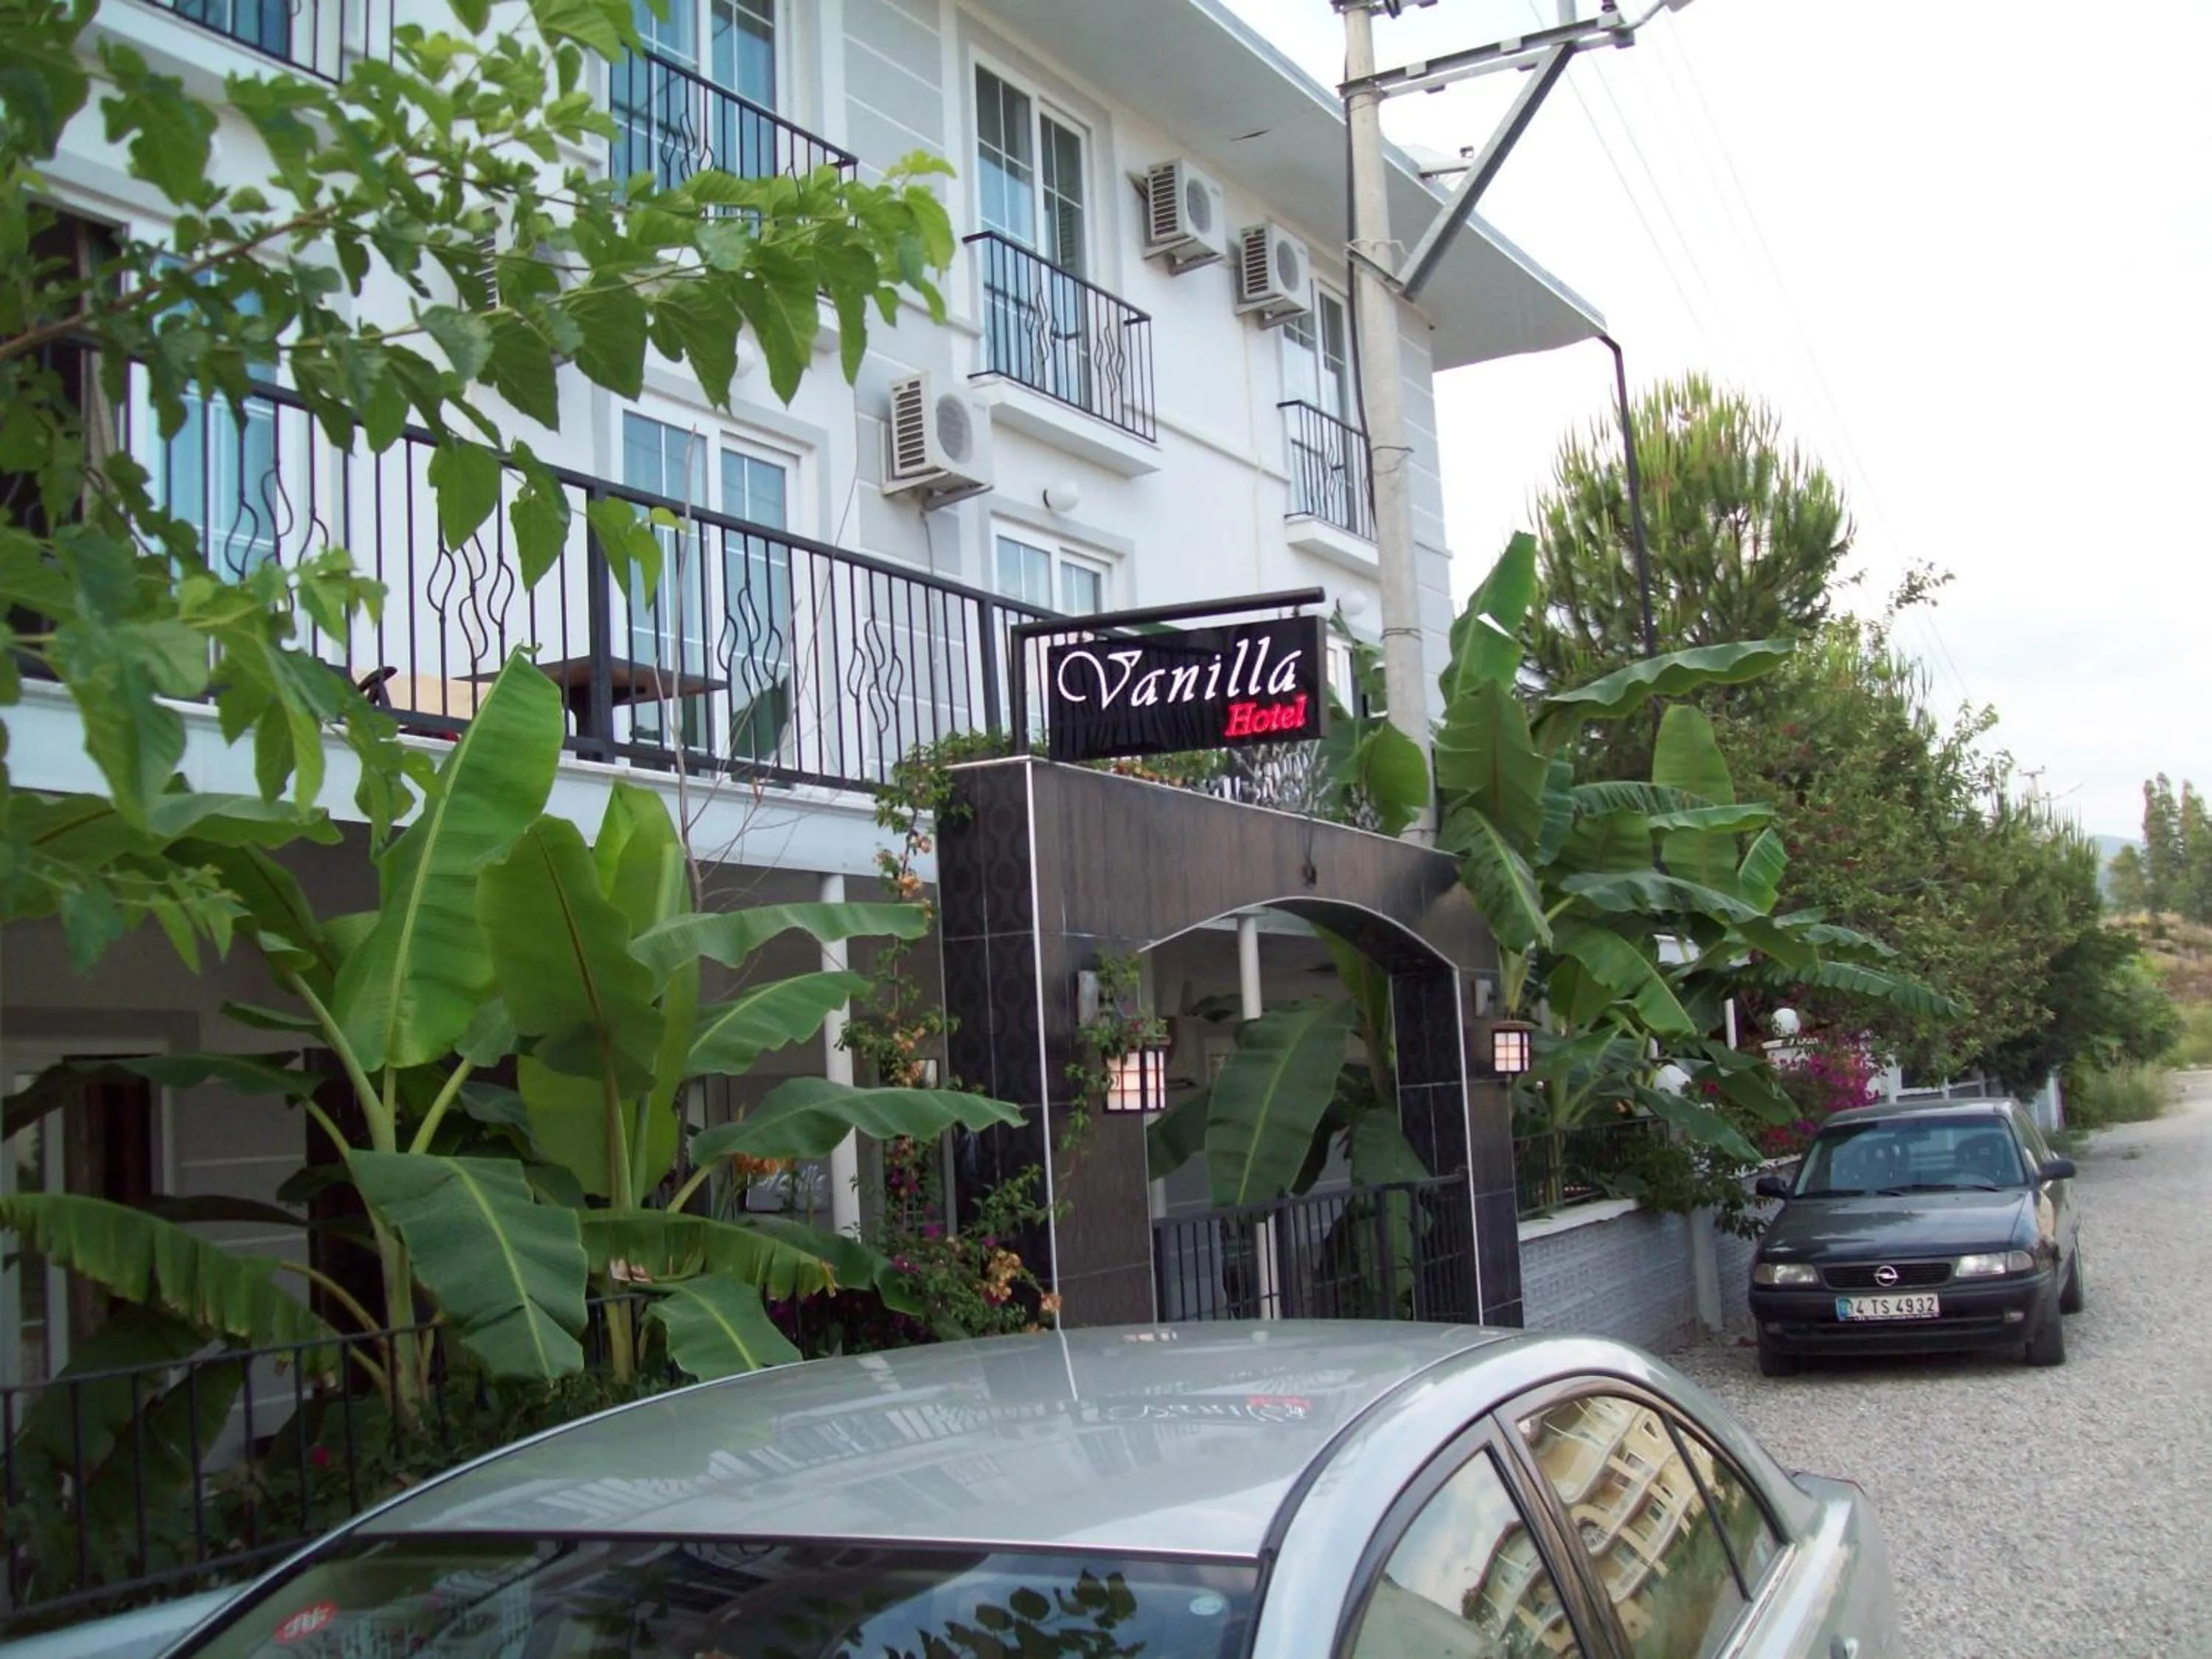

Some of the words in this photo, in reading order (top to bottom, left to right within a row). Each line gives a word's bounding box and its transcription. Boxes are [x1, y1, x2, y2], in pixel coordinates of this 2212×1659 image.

[1057, 636, 1303, 710] Vanilla
[1225, 693, 1308, 737] Hotel
[1871, 1299, 1890, 1315] TS
[1896, 1297, 1935, 1314] 4932
